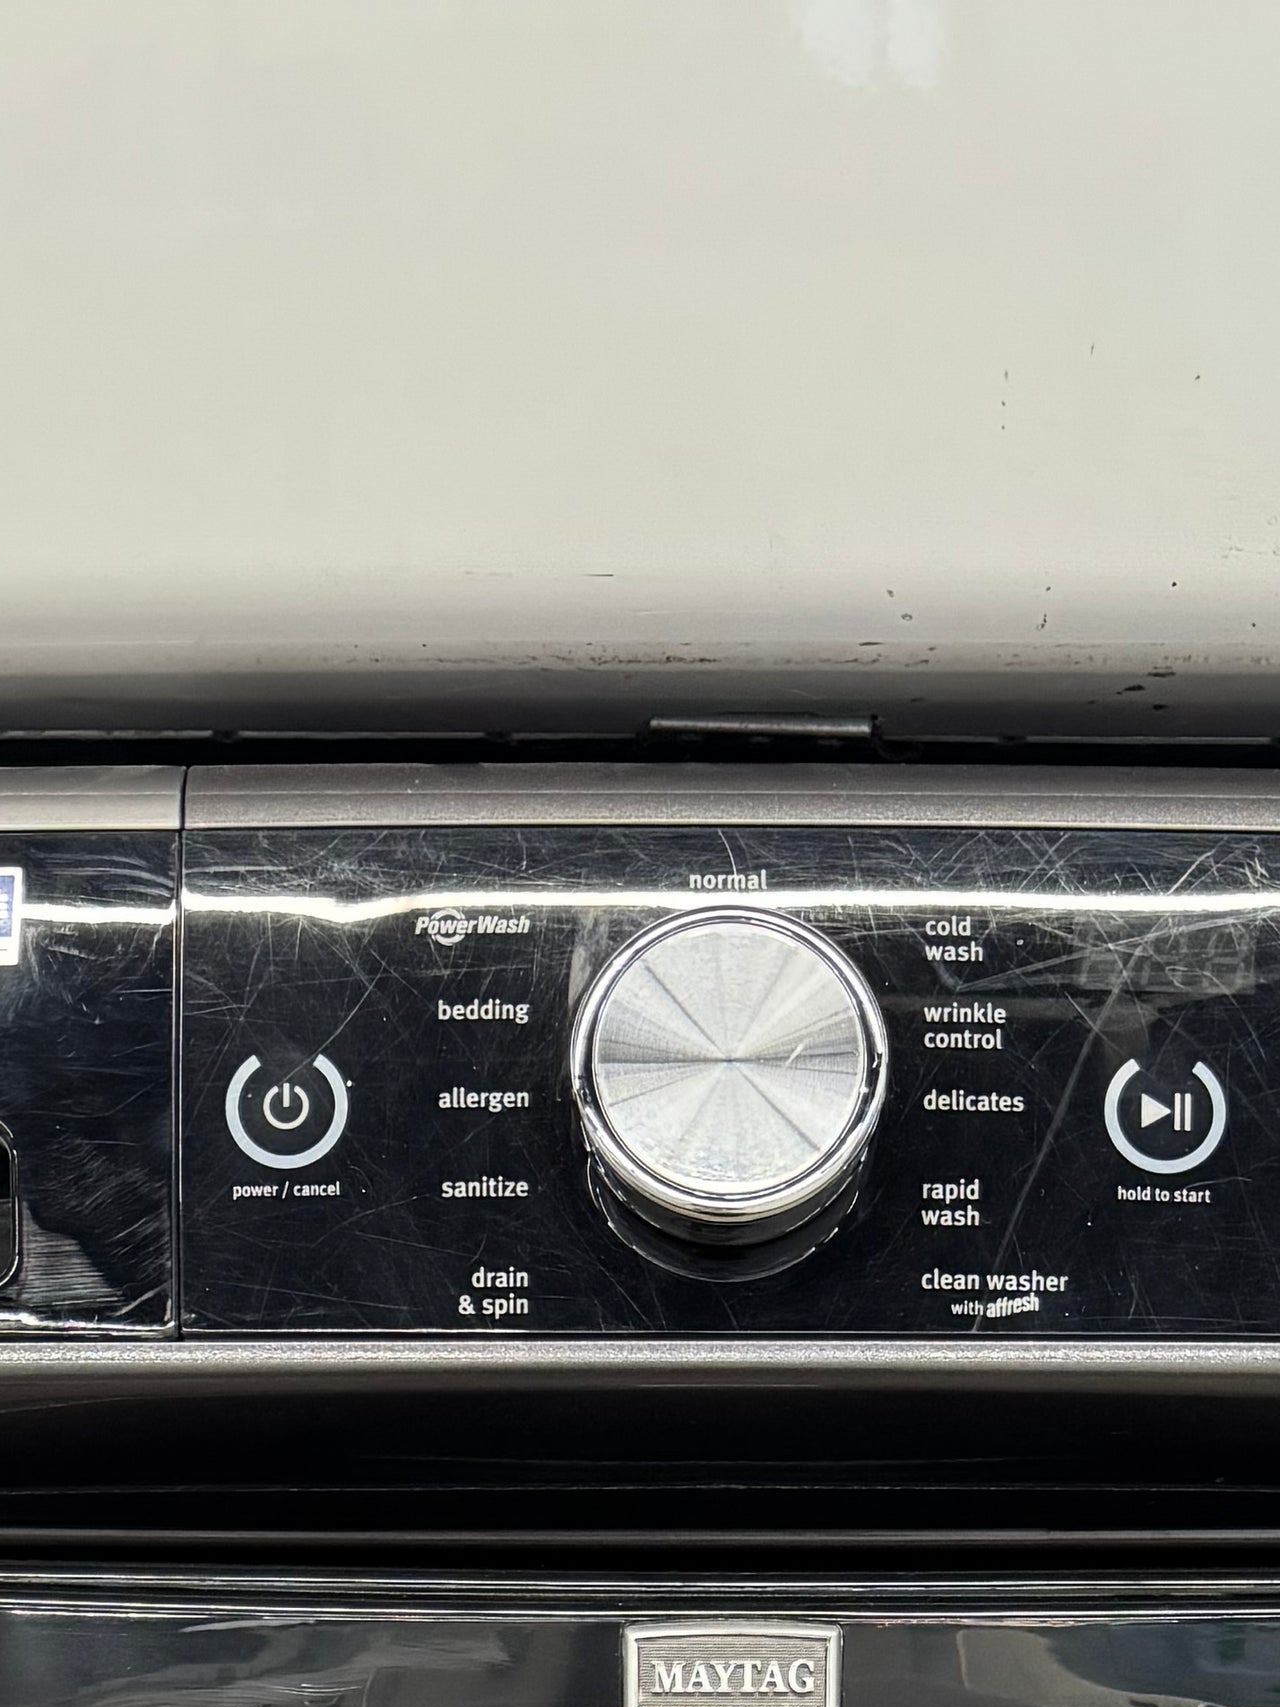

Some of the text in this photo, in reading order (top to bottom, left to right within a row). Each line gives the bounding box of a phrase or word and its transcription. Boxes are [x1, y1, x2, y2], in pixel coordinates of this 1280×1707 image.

[689, 871, 767, 890] normal
[415, 915, 530, 935] PowerWash
[926, 916, 971, 937] cold
[925, 941, 983, 961] wash
[439, 999, 529, 1023] bedding
[924, 1002, 1006, 1023] wrinkle
[925, 1029, 1001, 1049] control
[439, 1087, 529, 1112] allergen
[924, 1089, 1024, 1111] delicates
[233, 1181, 339, 1200] power / cancel
[442, 1176, 528, 1197] sanitize
[923, 1179, 979, 1204] rapid
[1118, 1186, 1210, 1202] hold to start
[922, 1203, 979, 1225] wash
[472, 1267, 528, 1287] drain
[922, 1269, 1068, 1294] clean washer
[459, 1293, 528, 1319] & spin
[951, 1292, 1040, 1318] with affresh
[651, 1659, 816, 1694] MAYTAG
